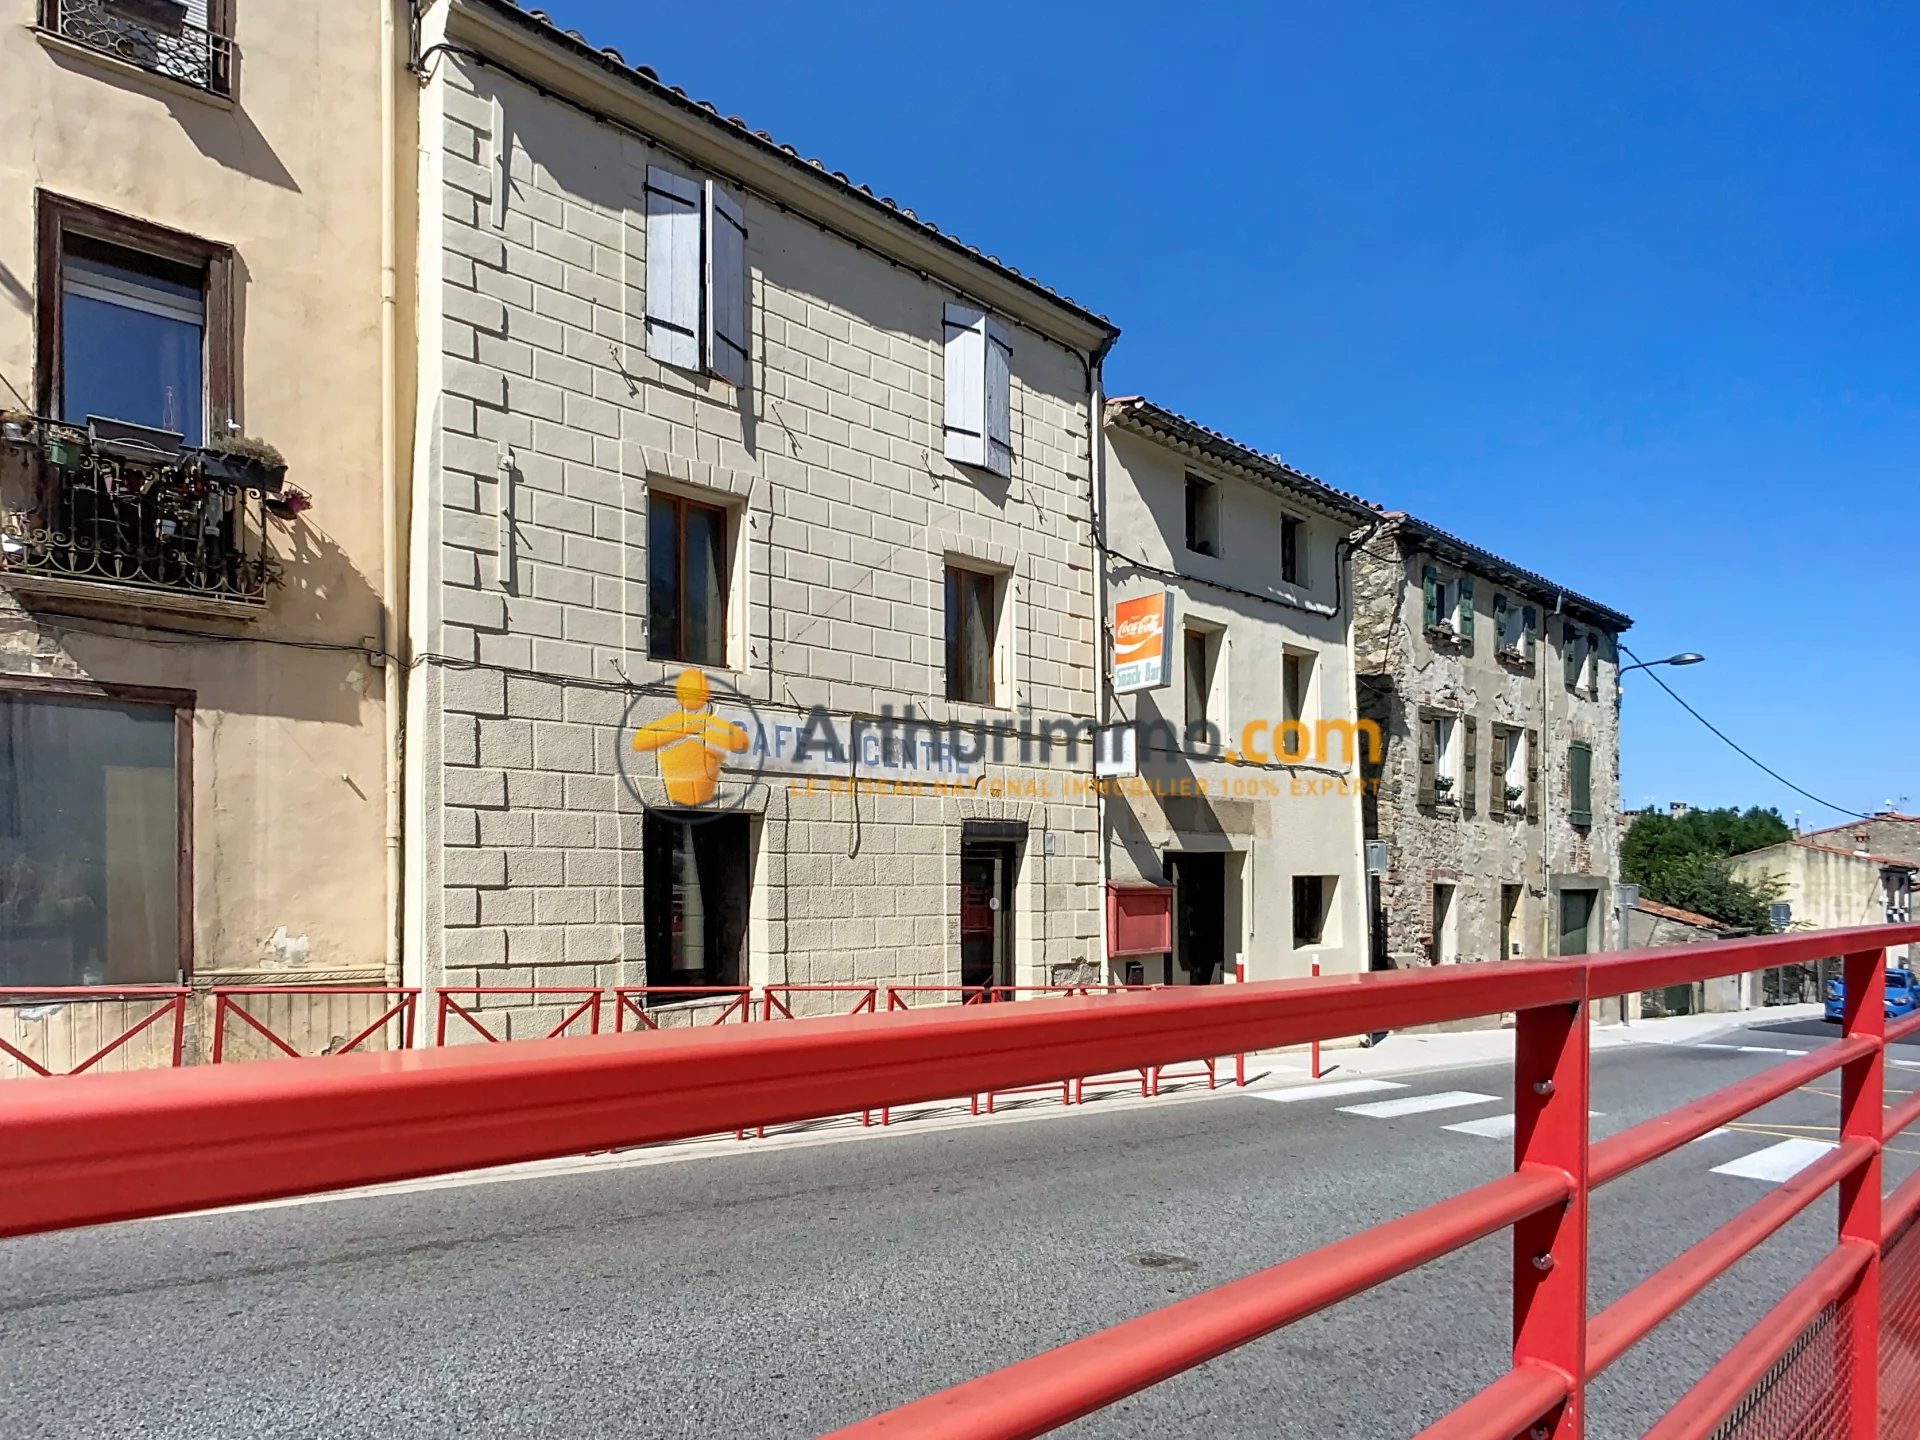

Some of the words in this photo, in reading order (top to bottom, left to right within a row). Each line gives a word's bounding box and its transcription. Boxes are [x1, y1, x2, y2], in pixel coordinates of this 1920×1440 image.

[1117, 664, 1141, 688] Snack
[1145, 661, 1161, 682] Bar
[863, 735, 969, 774] CENTRE
